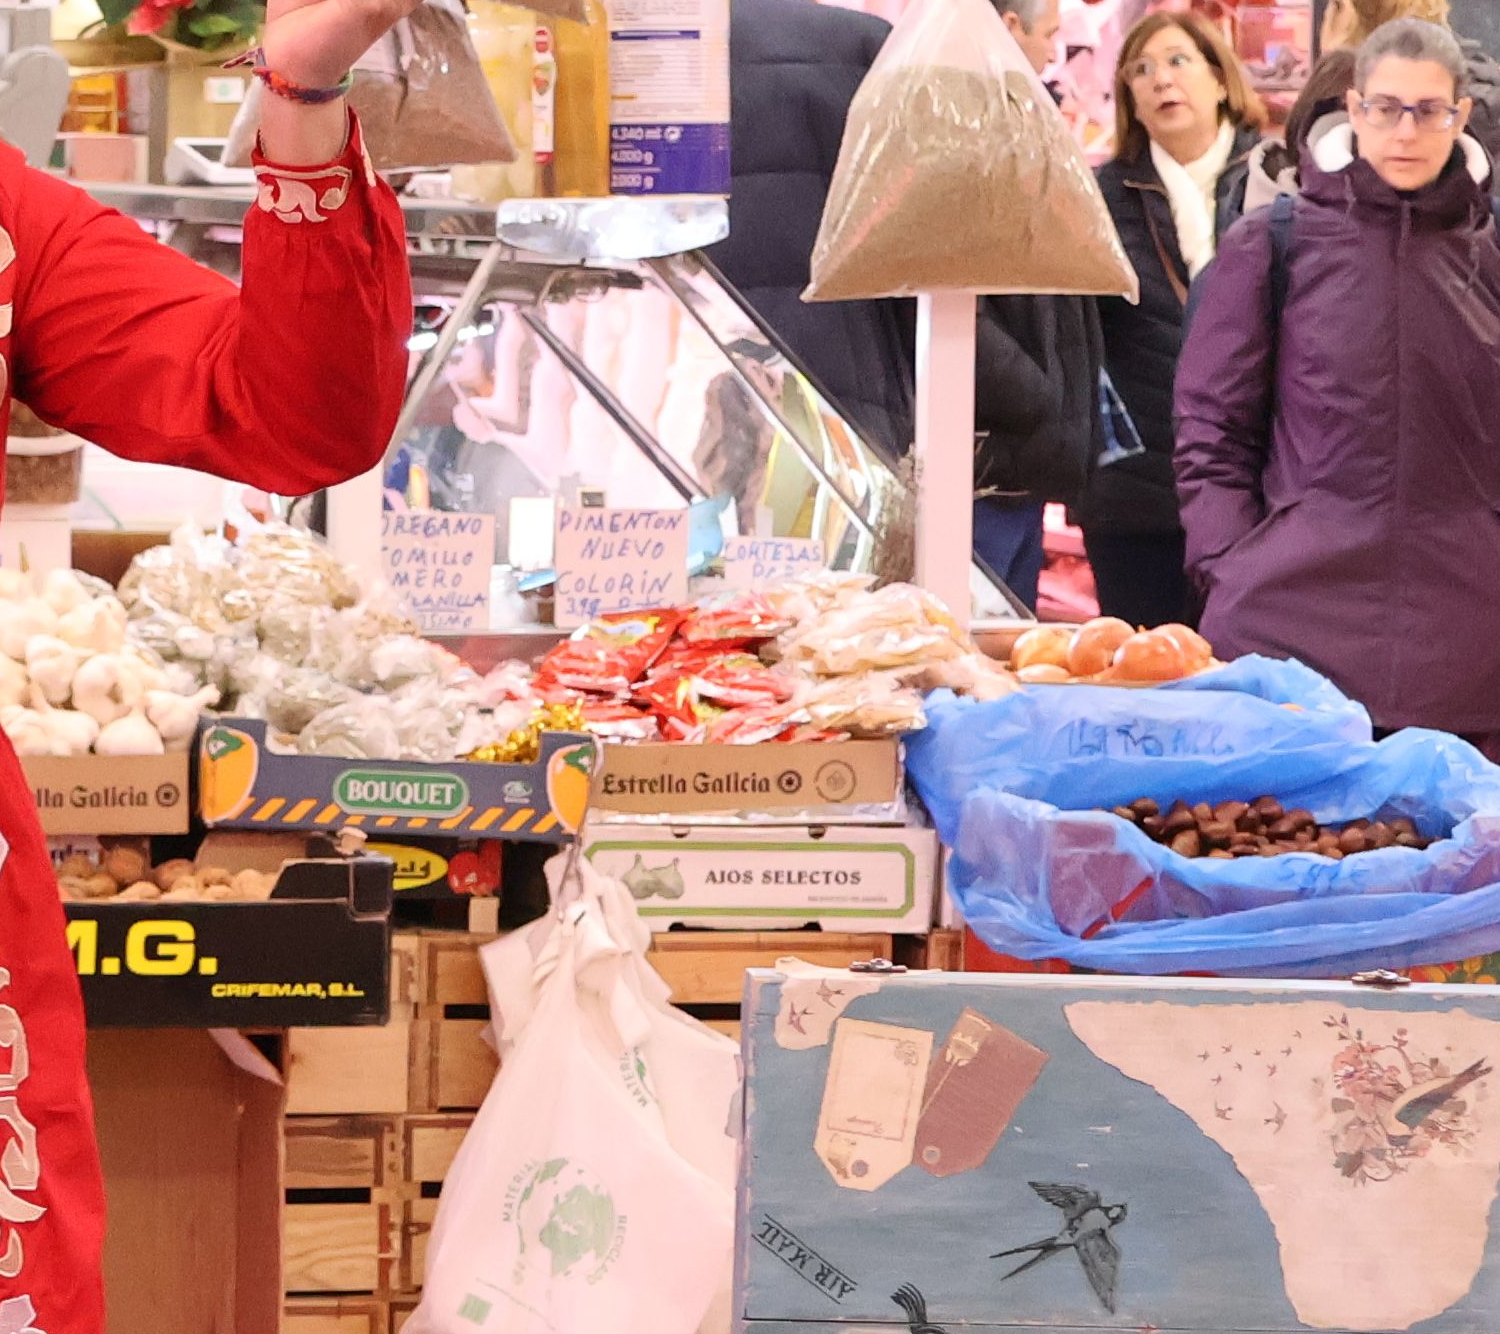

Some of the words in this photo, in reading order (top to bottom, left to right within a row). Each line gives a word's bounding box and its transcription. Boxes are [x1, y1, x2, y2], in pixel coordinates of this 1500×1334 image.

[580, 537, 666, 561] NUEVO
[70, 783, 150, 809] Galicia
[346, 778, 458, 807] BOUQUET
[601, 771, 689, 796] Estrella
[693, 770, 772, 795] Galicia
[760, 868, 863, 886] SELECTOS
[757, 1220, 815, 1269] MAIL
[814, 1263, 856, 1300] AIR
